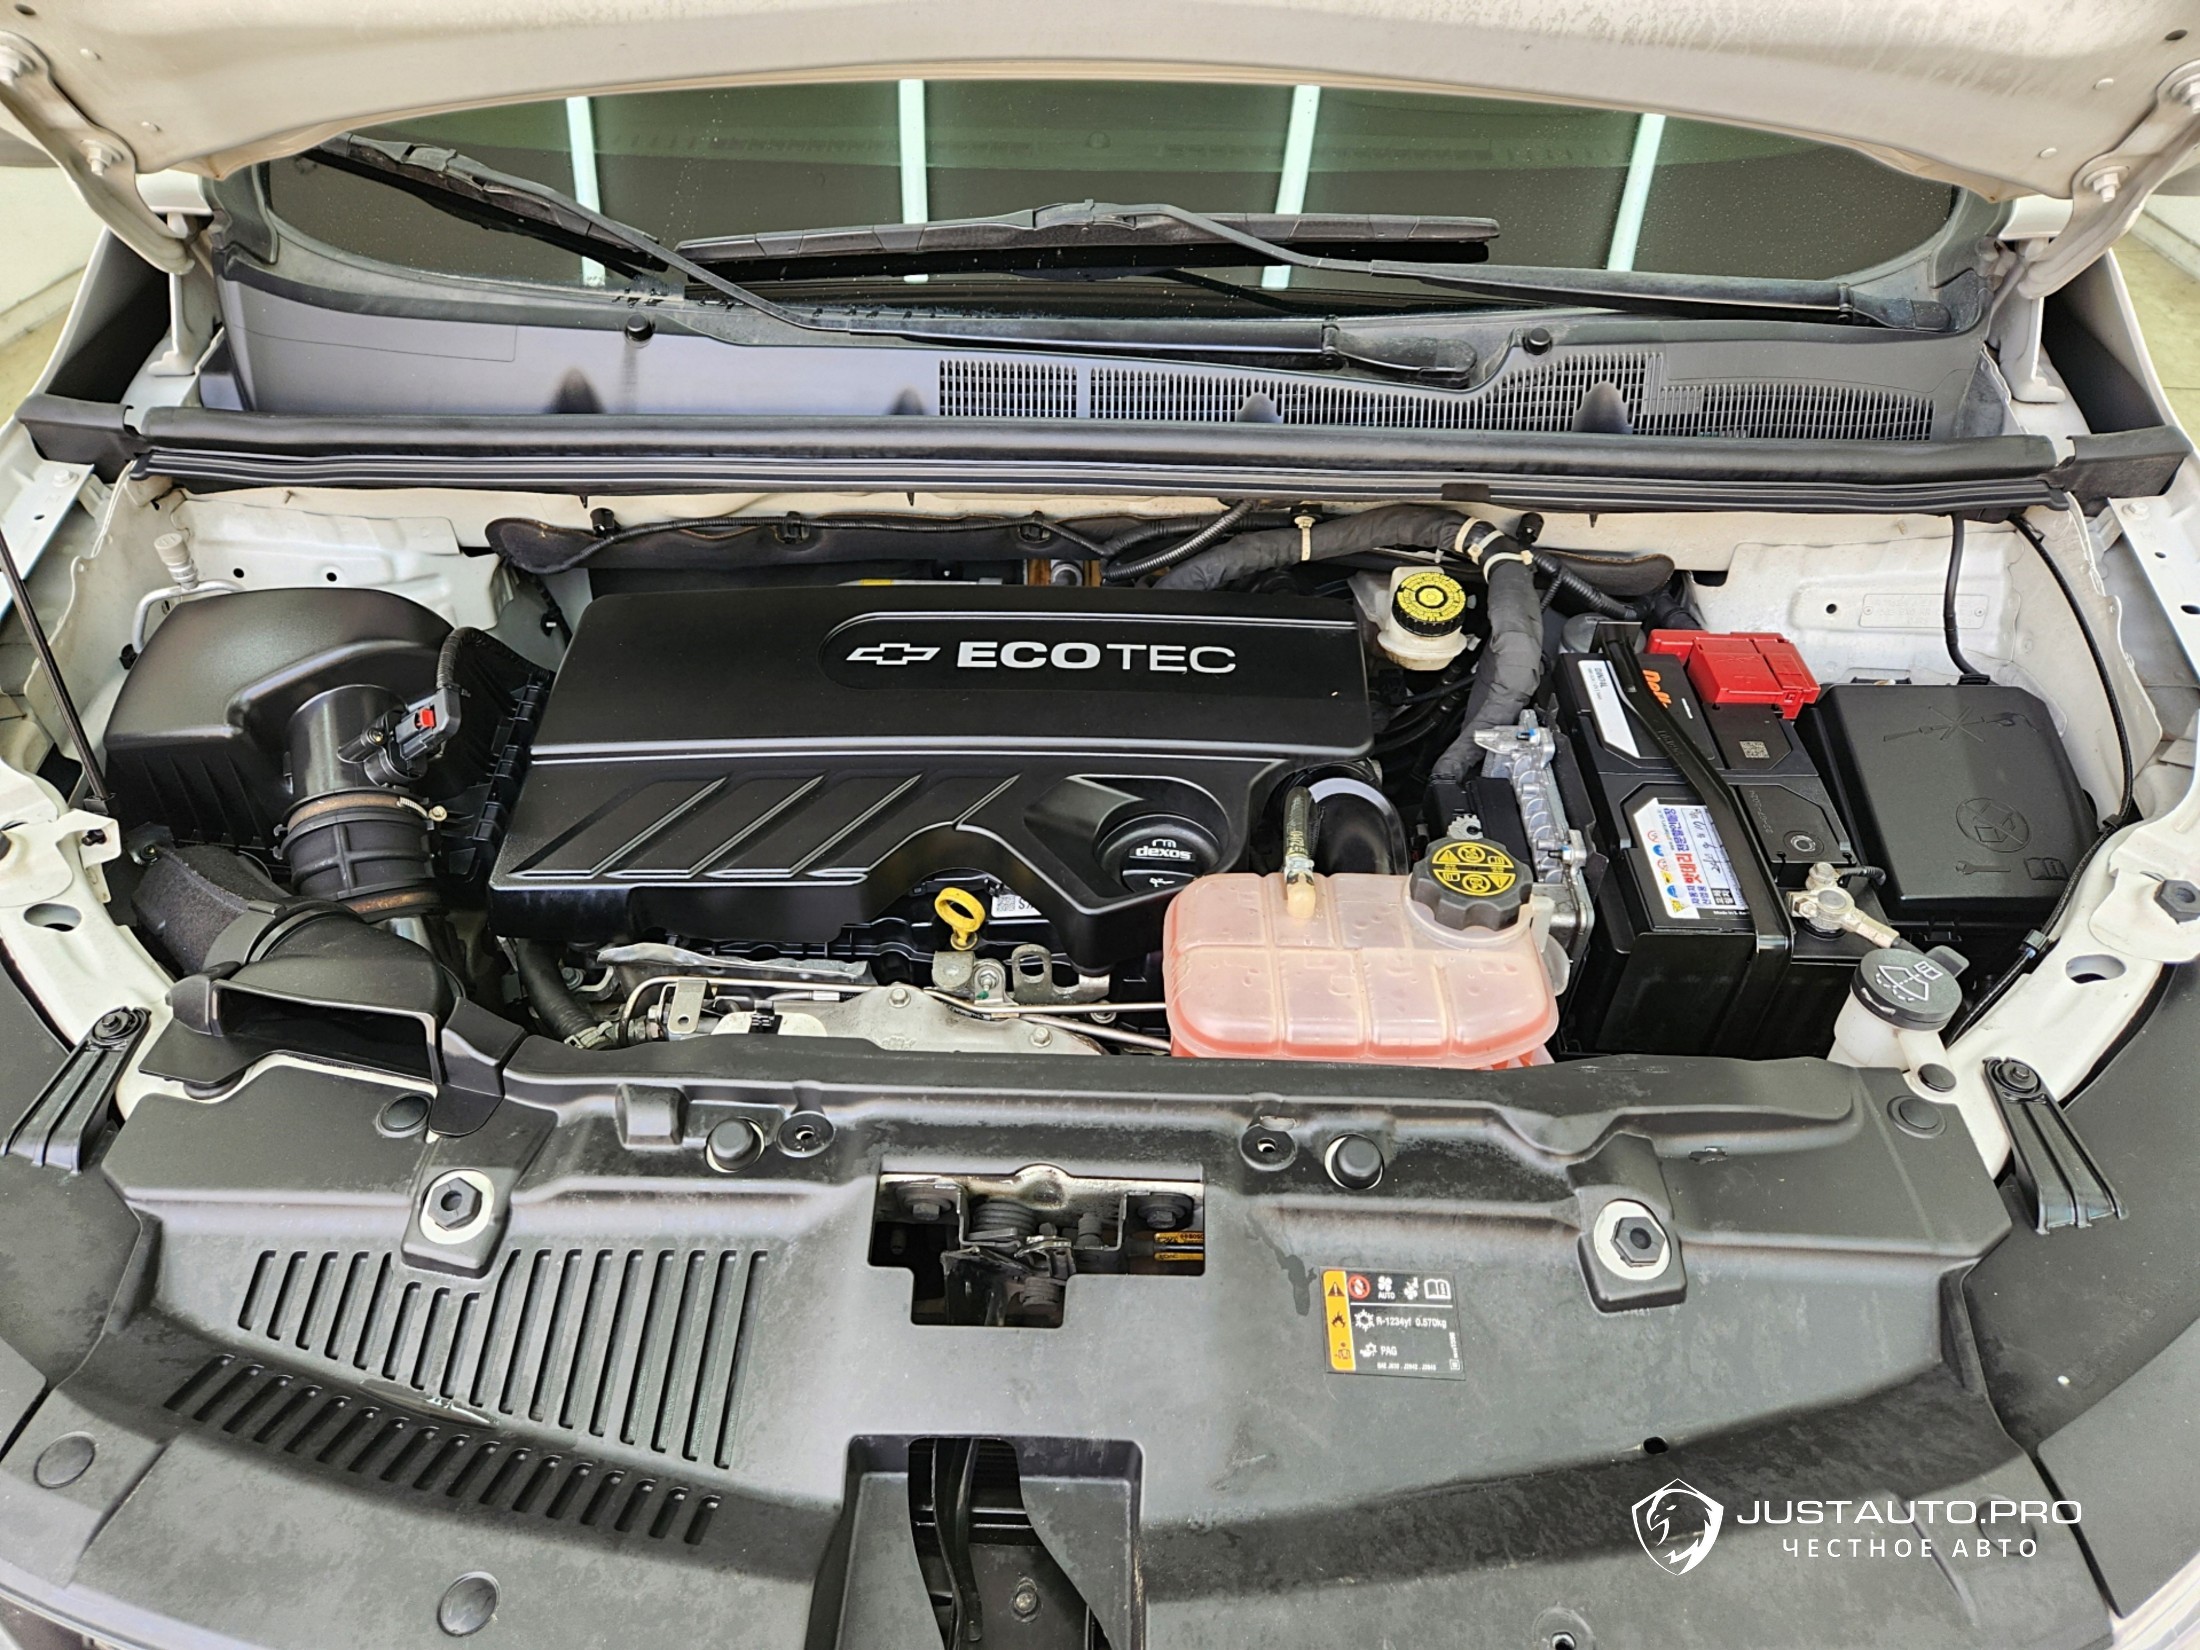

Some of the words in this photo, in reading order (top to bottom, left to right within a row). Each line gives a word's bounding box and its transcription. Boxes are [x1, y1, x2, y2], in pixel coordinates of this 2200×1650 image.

[957, 641, 1236, 674] ECOTEC
[1136, 845, 1192, 860] dexos
[1378, 1291, 1396, 1300] AUTO
[1376, 1315, 1411, 1329] R-1234yf
[1415, 1317, 1447, 1330] 0.570kg
[1380, 1345, 1398, 1357] PAG
